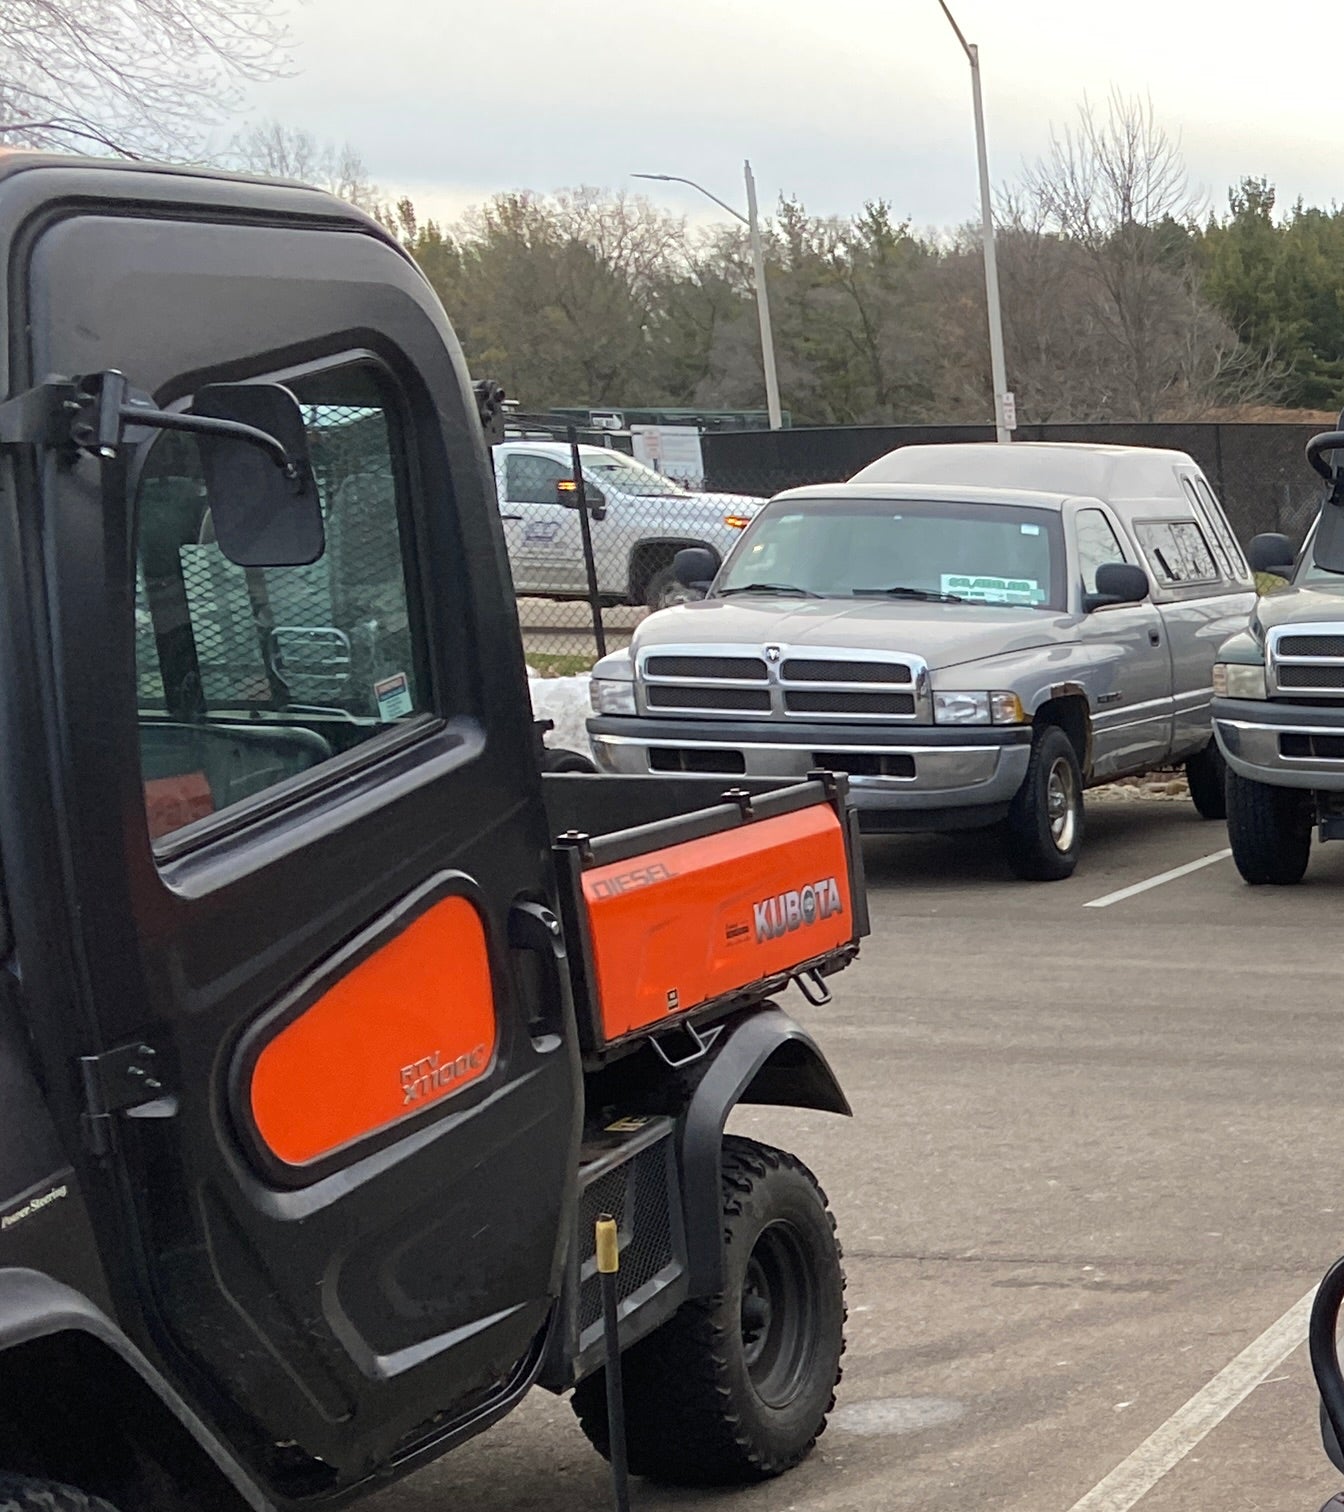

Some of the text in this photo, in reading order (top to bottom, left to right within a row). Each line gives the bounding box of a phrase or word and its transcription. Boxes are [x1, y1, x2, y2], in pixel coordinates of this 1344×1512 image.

[592, 863, 678, 899] DIESEL
[752, 877, 843, 944] KUBOTA
[400, 1050, 440, 1087] RTV
[30, 1185, 68, 1212] Steering
